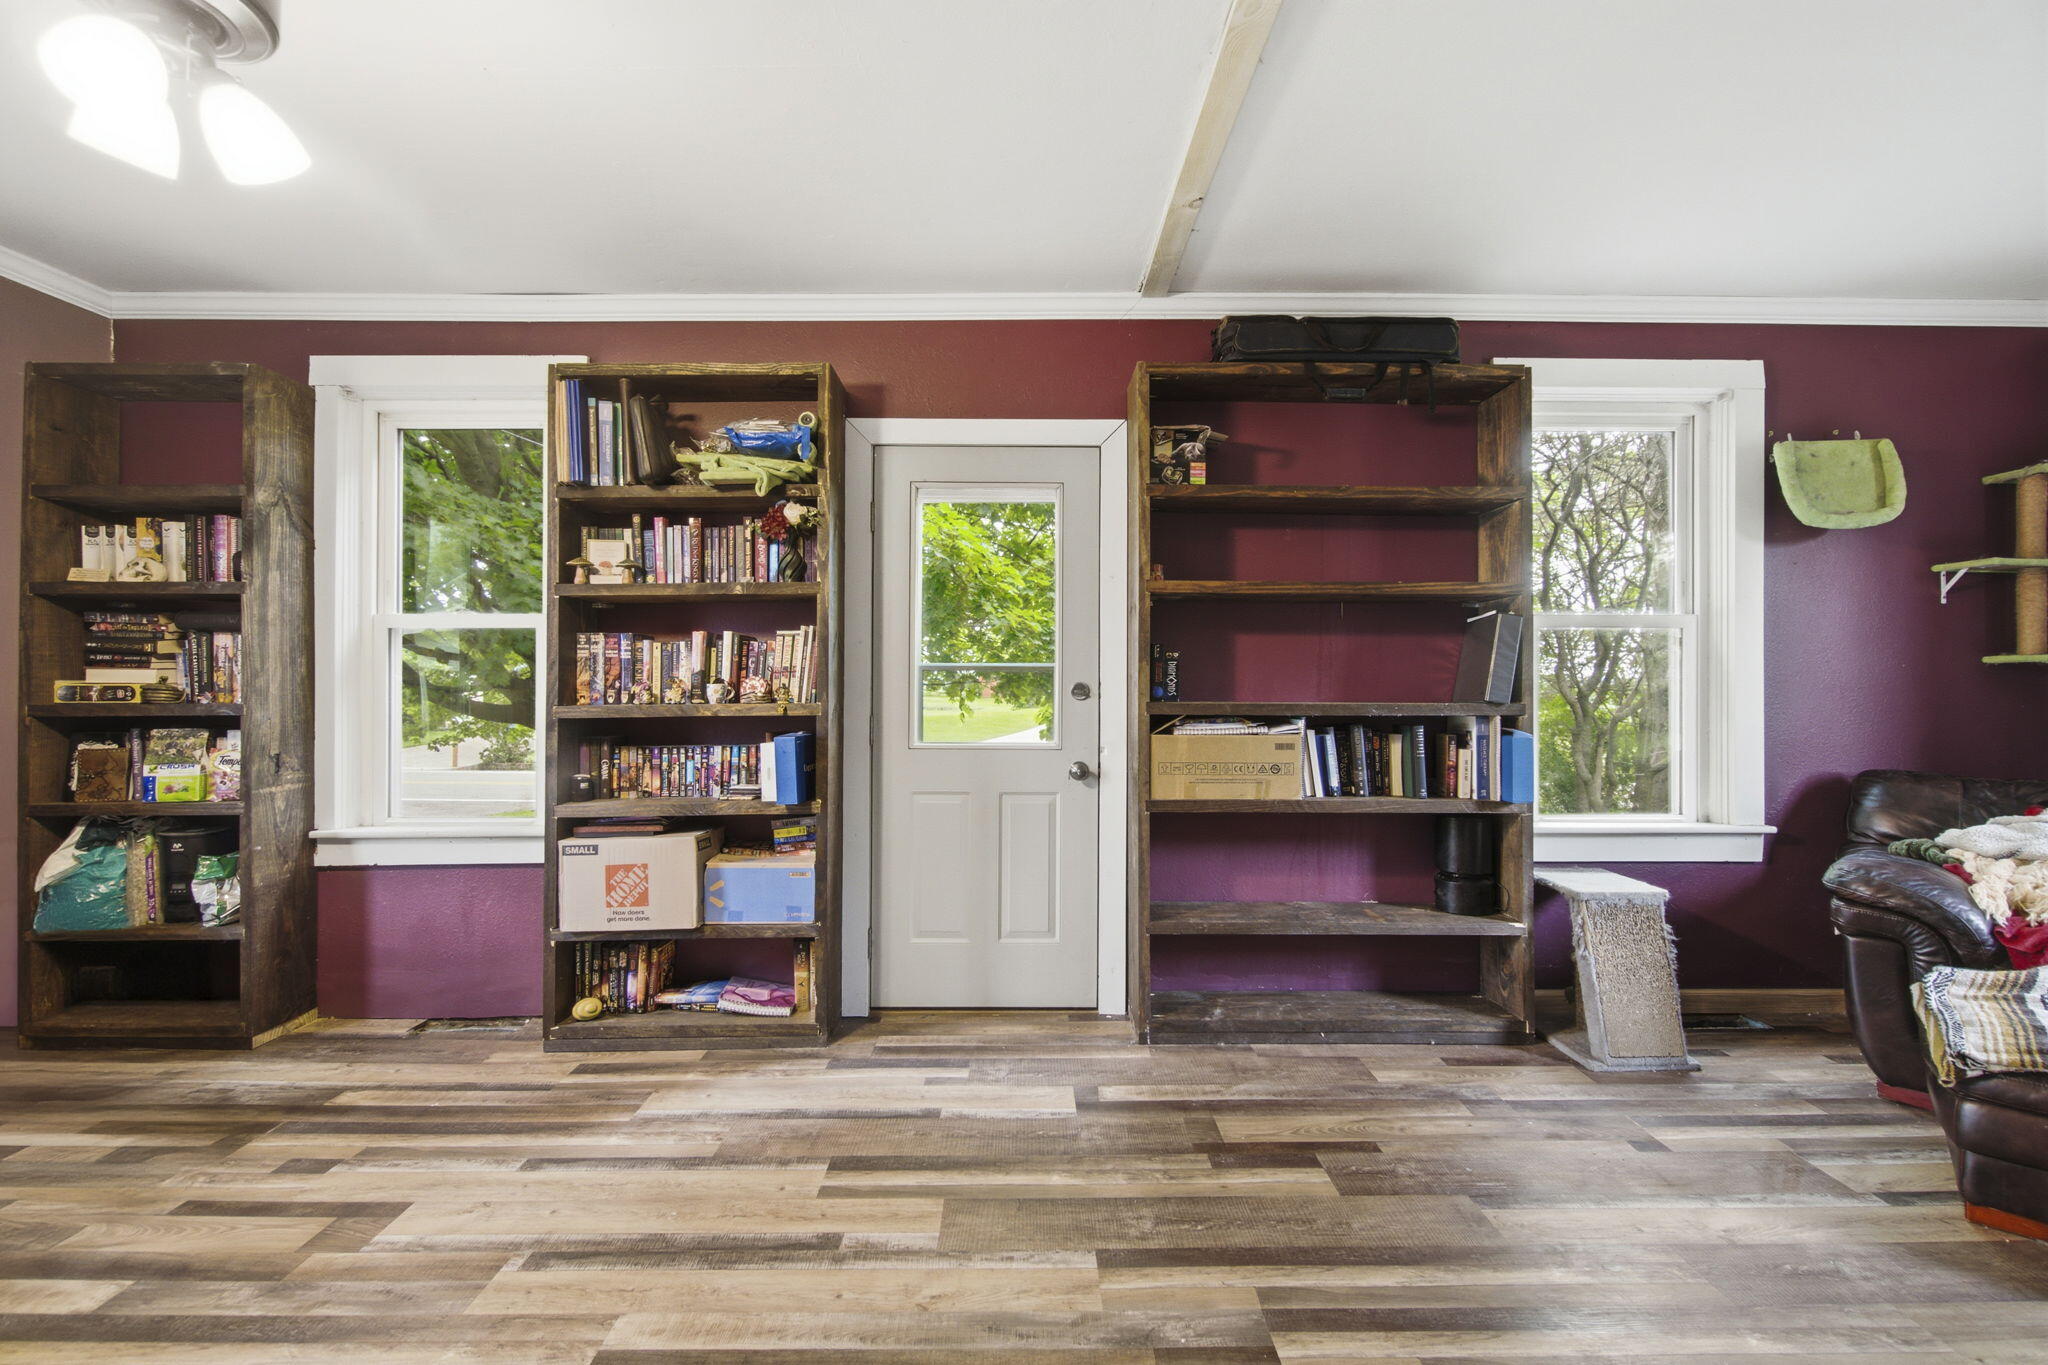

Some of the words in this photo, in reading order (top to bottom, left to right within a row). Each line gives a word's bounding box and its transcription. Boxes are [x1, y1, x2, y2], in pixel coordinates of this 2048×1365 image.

[1166, 661, 1178, 696] DIAMONDS
[565, 846, 596, 855] SMALL
[606, 863, 648, 907] HOME
[608, 868, 627, 886] THE
[622, 878, 649, 907] DEPOT
